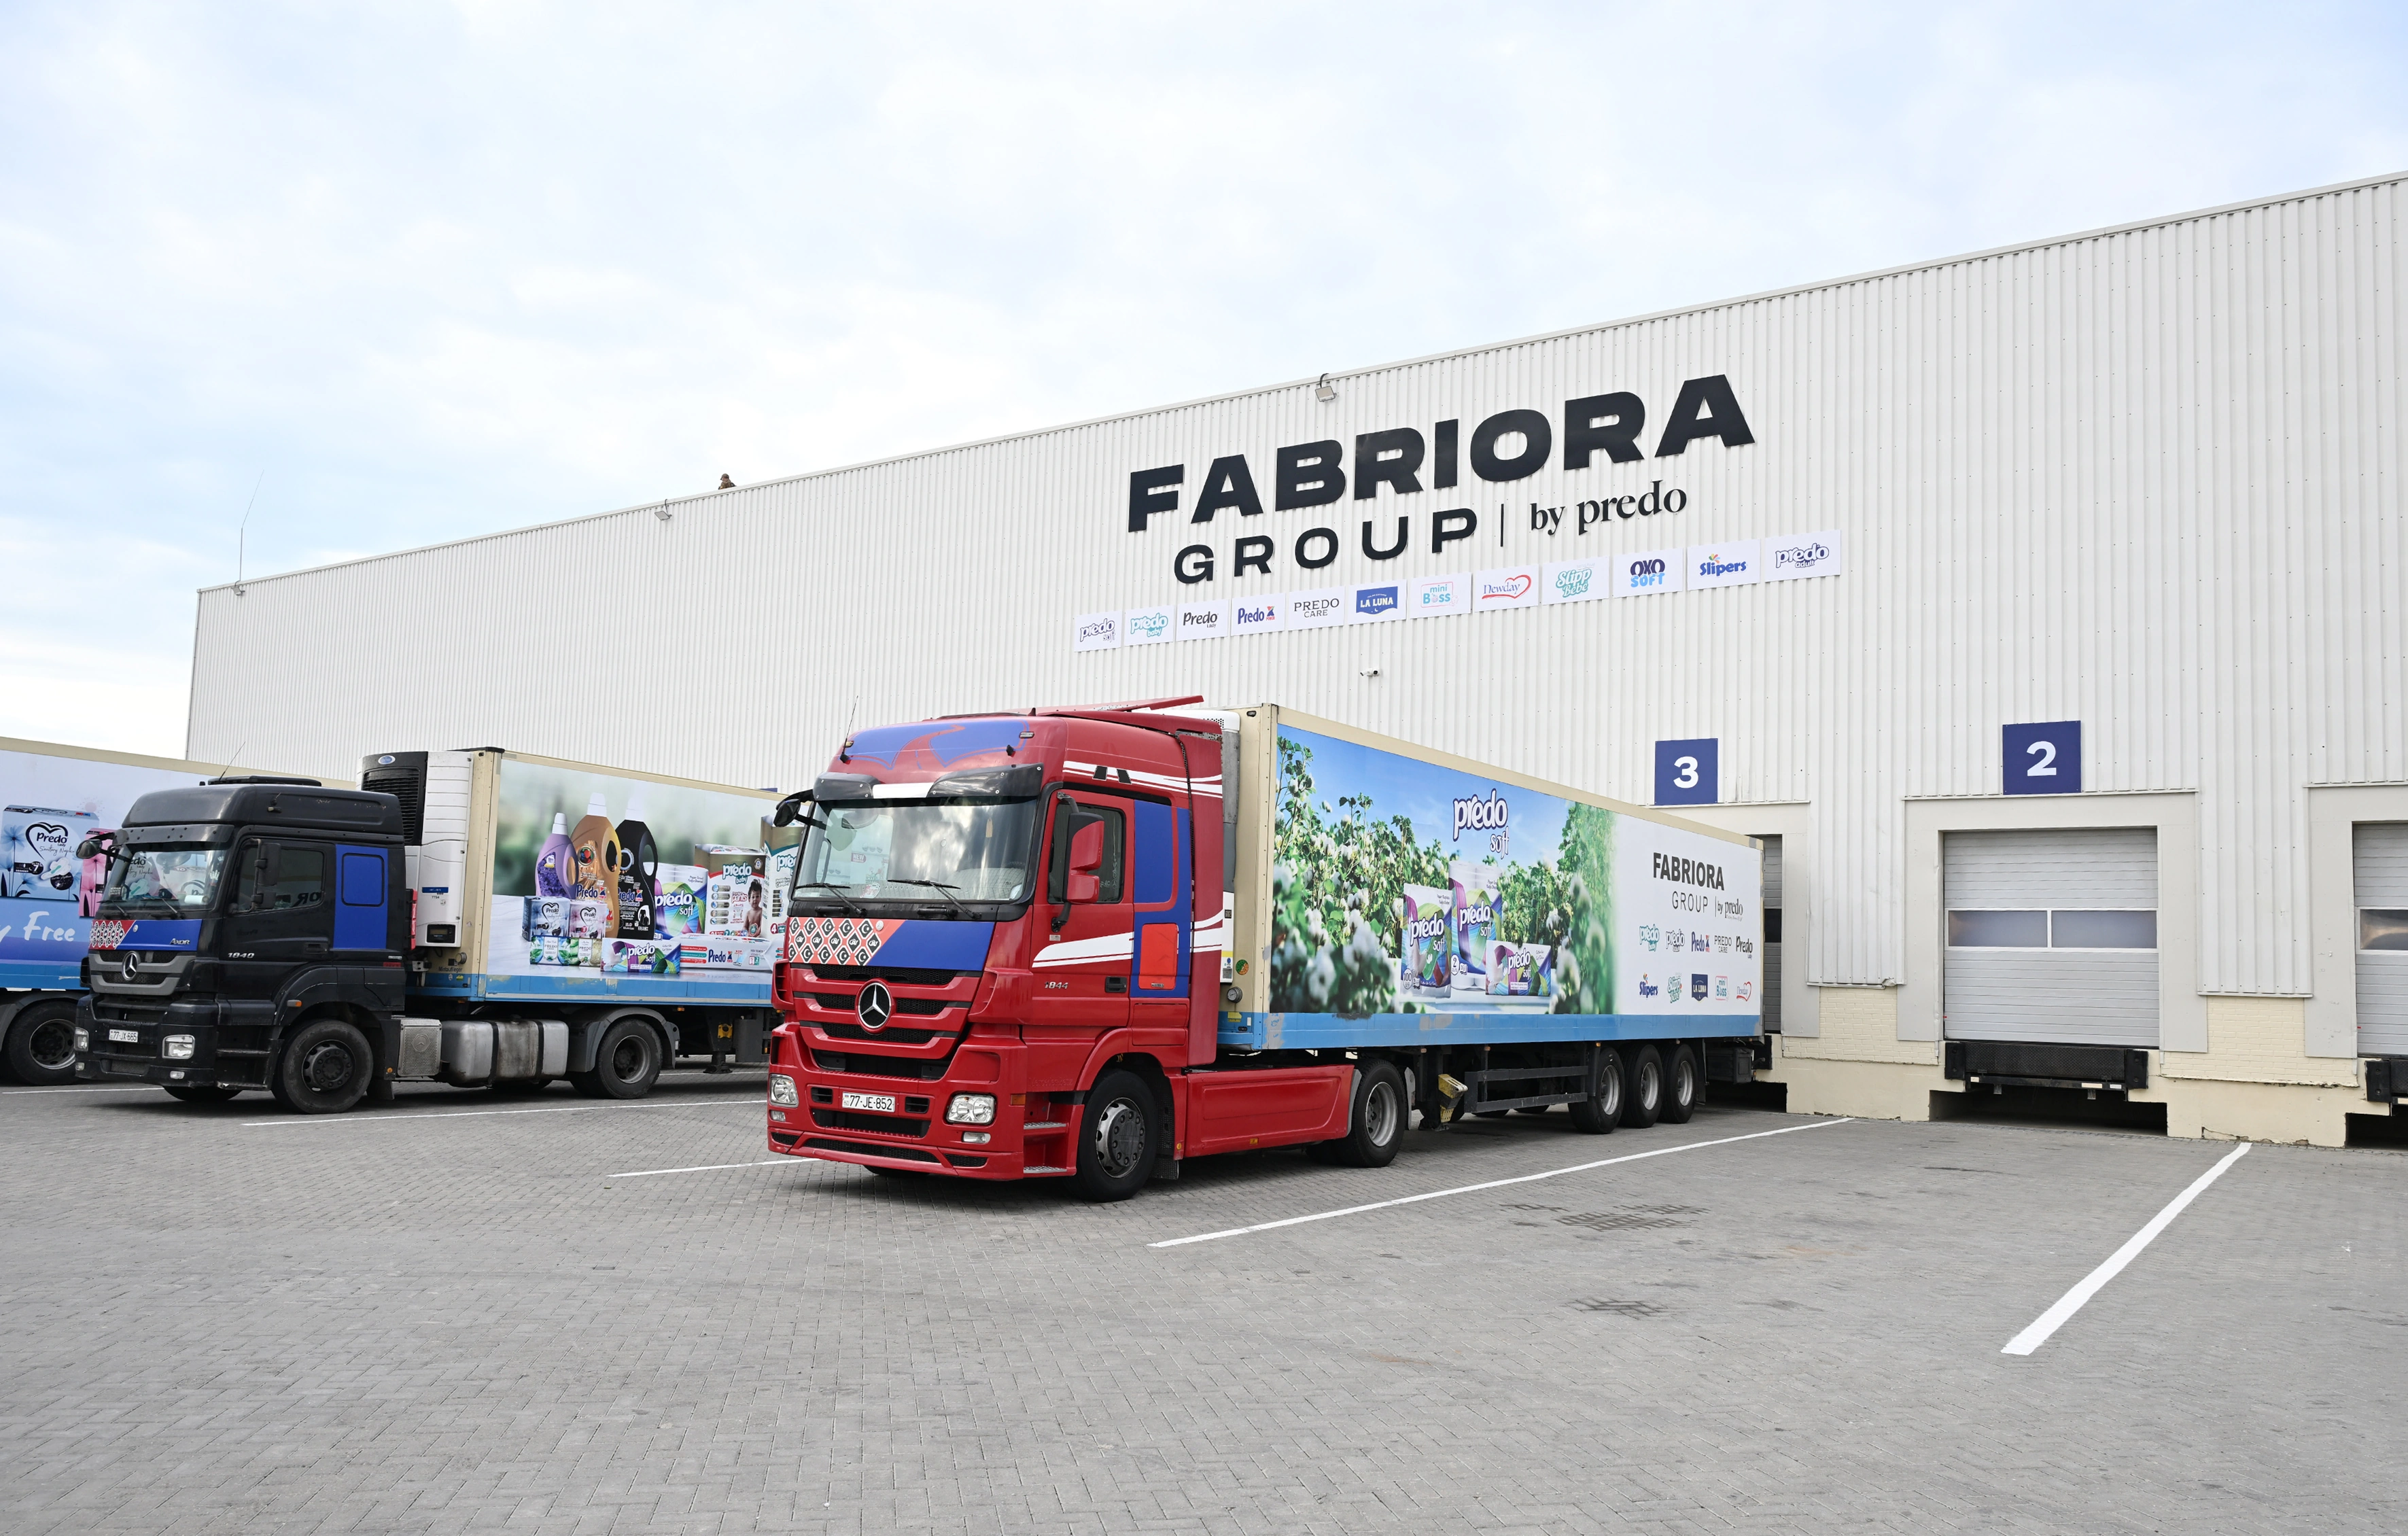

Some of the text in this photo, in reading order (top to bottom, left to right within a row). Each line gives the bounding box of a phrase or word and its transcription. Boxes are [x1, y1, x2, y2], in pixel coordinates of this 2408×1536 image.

[1128, 374, 1756, 531] FABRIORA
[1174, 480, 1688, 583] GROUP by predo
[1775, 543, 1830, 568] predo
[1795, 560, 1815, 569] adult
[1630, 559, 1666, 577] OXO
[1699, 561, 1747, 577] Slipers
[1556, 568, 1592, 589] Slipp
[1630, 572, 1665, 588] SOFT
[1429, 584, 1448, 593] mini
[1484, 582, 1520, 595] Newday
[1293, 598, 1340, 612] PREDO
[1360, 597, 1393, 608] LA LUNA
[1130, 612, 1168, 634] predo
[1183, 610, 1218, 626] Predo
[1237, 607, 1265, 625] Predo
[1304, 610, 1328, 618] CARE
[1080, 618, 1115, 642] predo
[1102, 631, 1115, 643] soft
[1147, 627, 1163, 638] baby
[2026, 740, 2058, 776] 2
[1673, 756, 1700, 788] 3
[1452, 788, 1508, 842] predo
[36, 832, 67, 843] Predo
[1490, 826, 1510, 860] soft
[33, 864, 39, 872] 7
[129, 857, 147, 866] edo
[722, 861, 752, 879] predo
[776, 854, 797, 872] pre
[735, 875, 748, 884] baby
[1653, 852, 1725, 891] FABRIORA
[576, 884, 598, 898] Predo
[655, 889, 693, 909] predo
[679, 905, 694, 917] soft
[1672, 890, 1743, 918] GROUP by predo
[1459, 899, 1491, 932] predo
[22, 911, 75, 942] Free
[771, 924, 778, 933] 4
[1410, 911, 1445, 947] predo
[1480, 921, 1492, 939] soft
[1639, 924, 1660, 945] predo
[1433, 935, 1446, 955] soft
[1666, 928, 1686, 949] predo
[1691, 931, 1705, 952] Predo
[1714, 935, 1732, 947] PREDO
[1736, 936, 1753, 954] Predo
[627, 942, 656, 960] predo
[708, 949, 727, 964] Predo
[1508, 947, 1531, 976] predo
[1044, 981, 1069, 990] 1844
[1403, 973, 1412, 981] 100
[1639, 981, 1658, 998] Slipers
